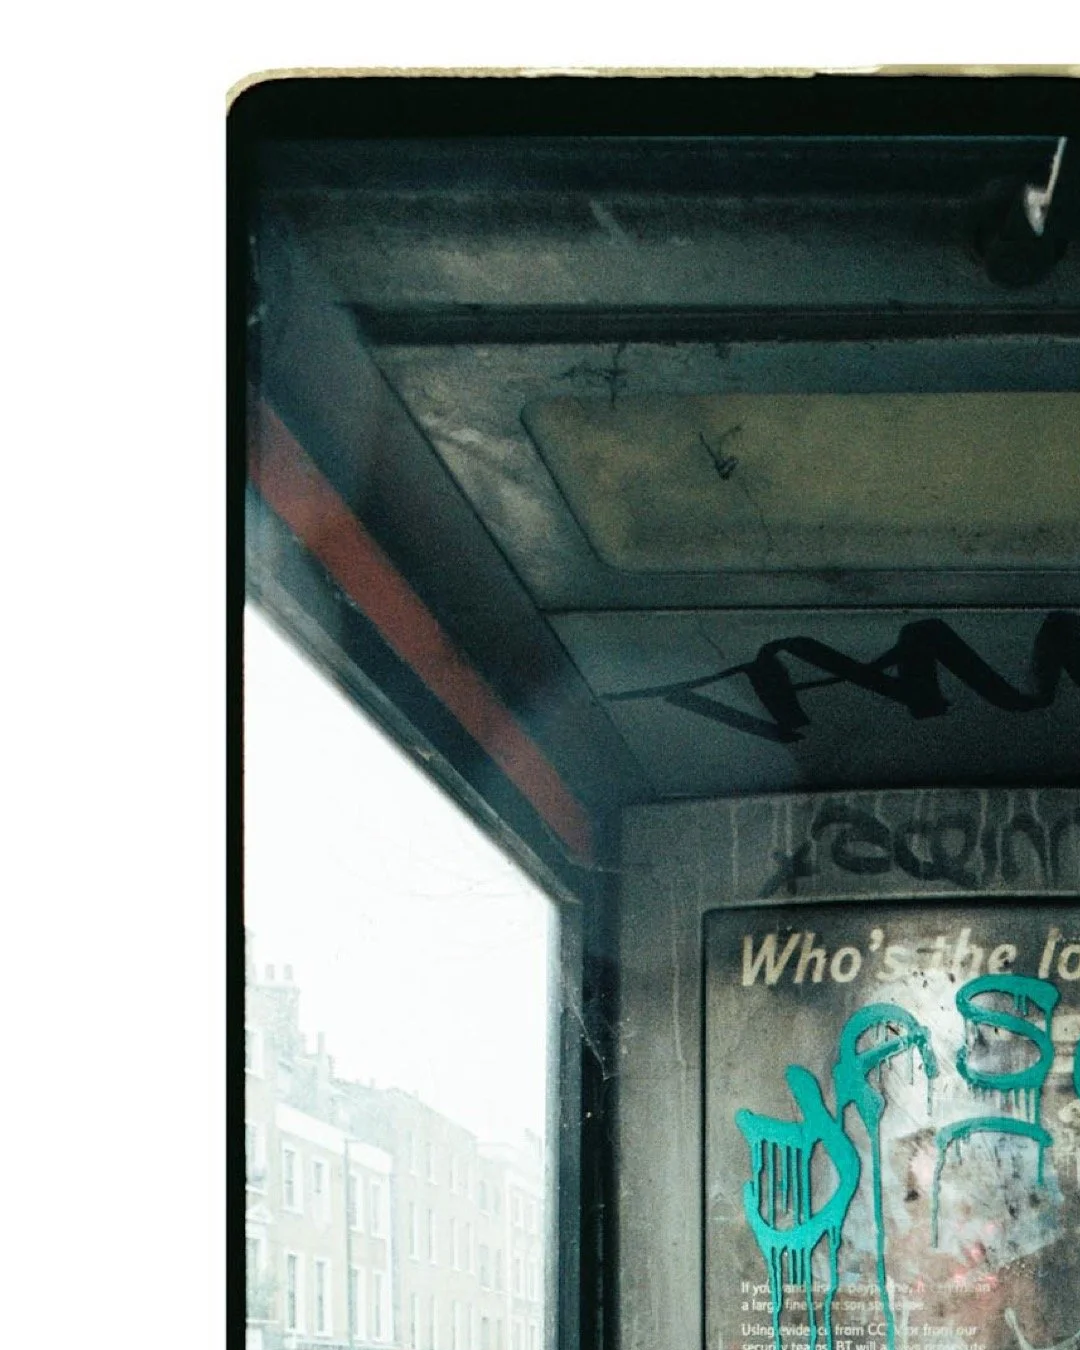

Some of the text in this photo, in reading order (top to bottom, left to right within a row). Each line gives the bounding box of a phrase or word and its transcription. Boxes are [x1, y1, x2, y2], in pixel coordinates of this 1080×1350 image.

[741, 929, 909, 987] Who's
[931, 927, 1017, 978] the
[741, 1301, 749, 1311] a
[752, 1298, 780, 1314] larg
[742, 1323, 775, 1338] Using
[780, 1323, 831, 1336] evidec
